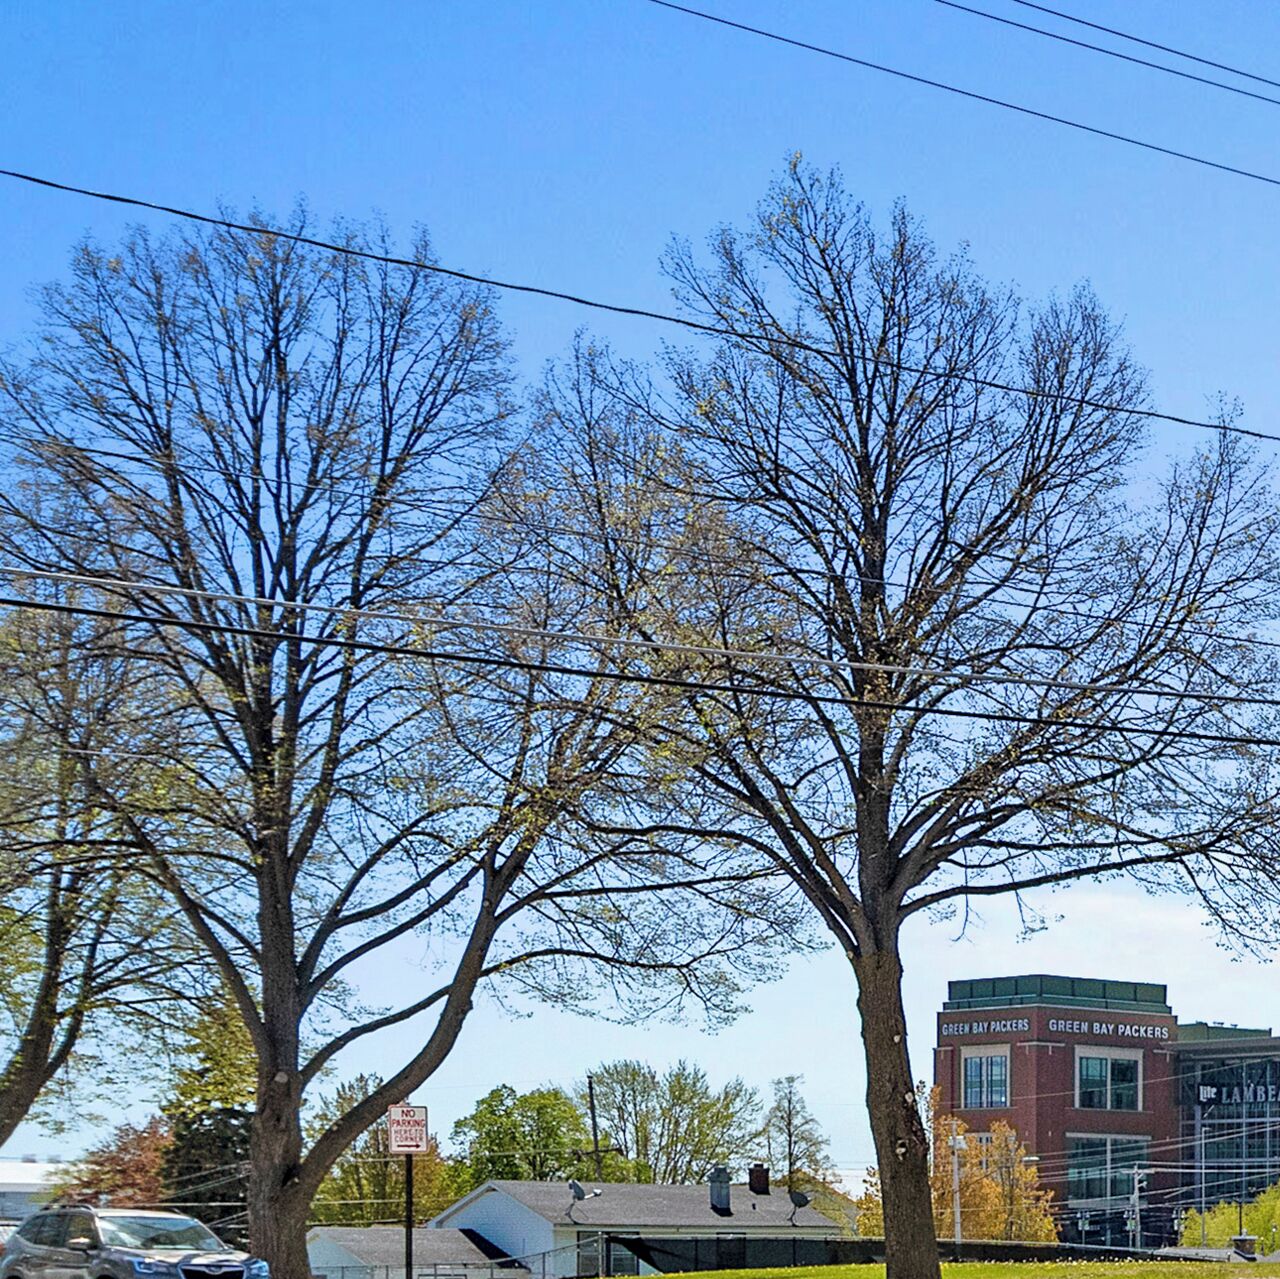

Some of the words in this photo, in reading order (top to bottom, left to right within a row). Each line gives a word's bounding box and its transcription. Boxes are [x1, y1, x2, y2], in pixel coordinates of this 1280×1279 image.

[942, 1022, 970, 1036] GREEN
[972, 1020, 988, 1034] BAY
[990, 1018, 1029, 1033] PACKERS
[1048, 1019, 1088, 1033] GREEN
[1093, 1022, 1114, 1035] BAY
[1117, 1025, 1169, 1039] PACKERS
[1199, 1085, 1217, 1101] Lite
[401, 1109, 416, 1118] NO
[391, 1119, 425, 1128] PARKING
